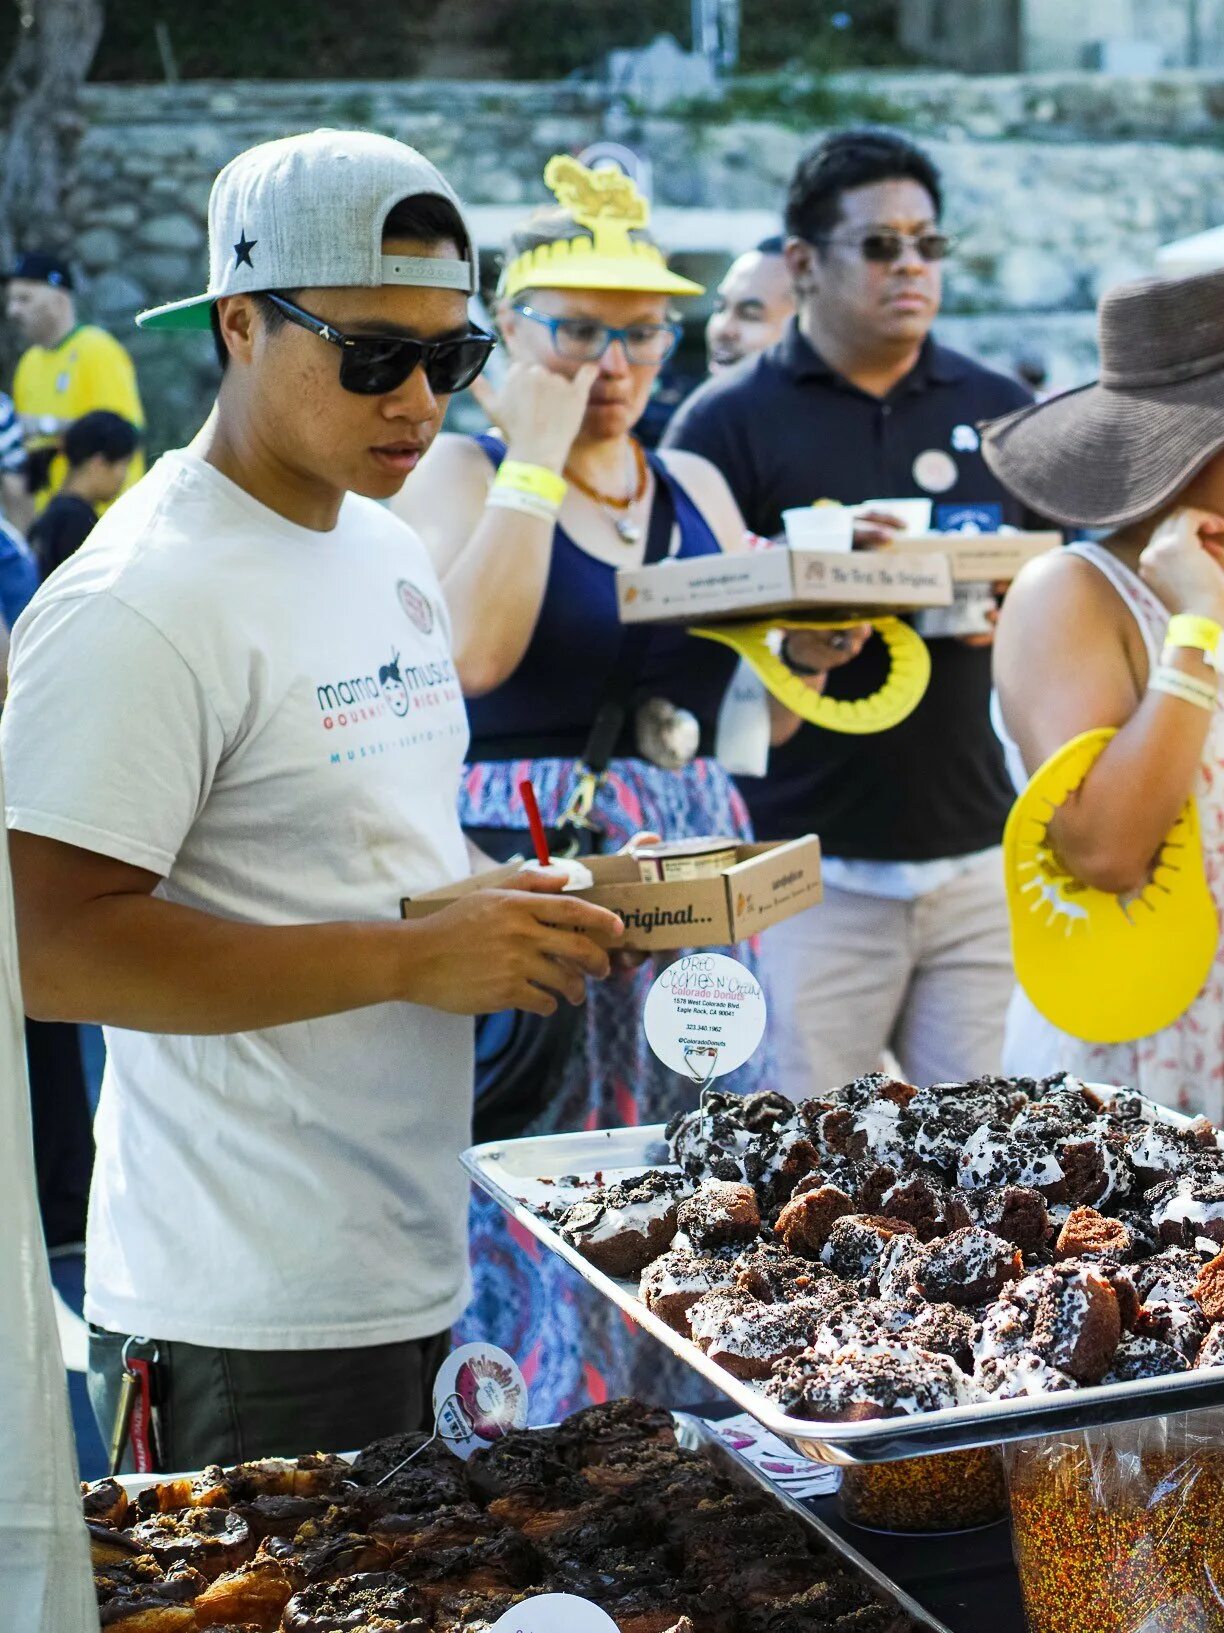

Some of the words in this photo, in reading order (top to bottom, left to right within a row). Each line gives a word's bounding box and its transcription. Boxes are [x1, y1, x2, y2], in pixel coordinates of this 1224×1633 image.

[316, 675, 380, 711] mama
[671, 985, 712, 998] Colorado
[713, 989, 745, 1001] Donuts
[702, 1000, 727, 1008] Colorado
[677, 1006, 692, 1014] Eagle
[678, 1037, 726, 1047] @ColoradoDonuts
